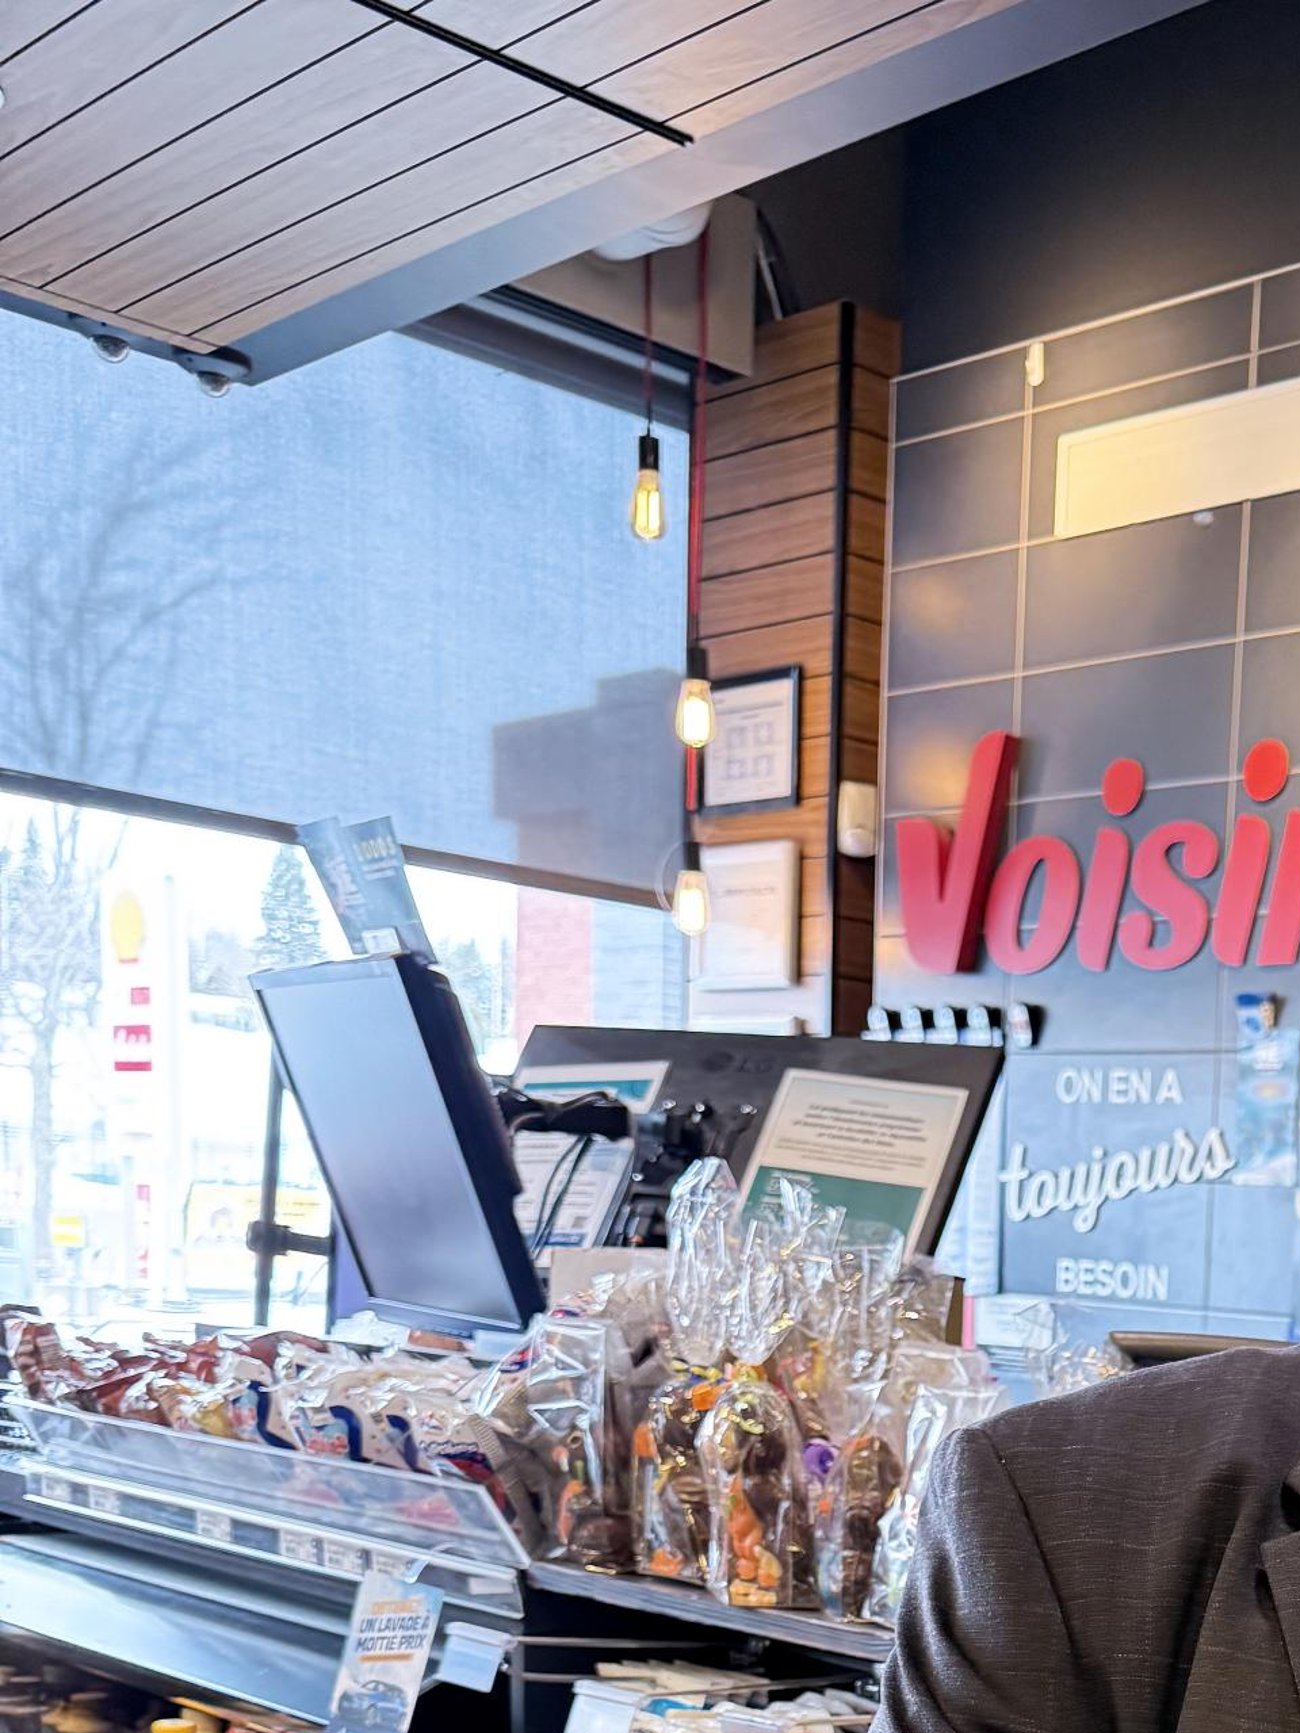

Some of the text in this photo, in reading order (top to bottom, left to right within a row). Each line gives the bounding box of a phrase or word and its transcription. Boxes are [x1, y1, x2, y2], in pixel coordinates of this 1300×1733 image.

[1055, 1066, 1184, 1106] ON EN A
[998, 1126, 1239, 1234] toujours
[1055, 1257, 1169, 1301] BESOIN
